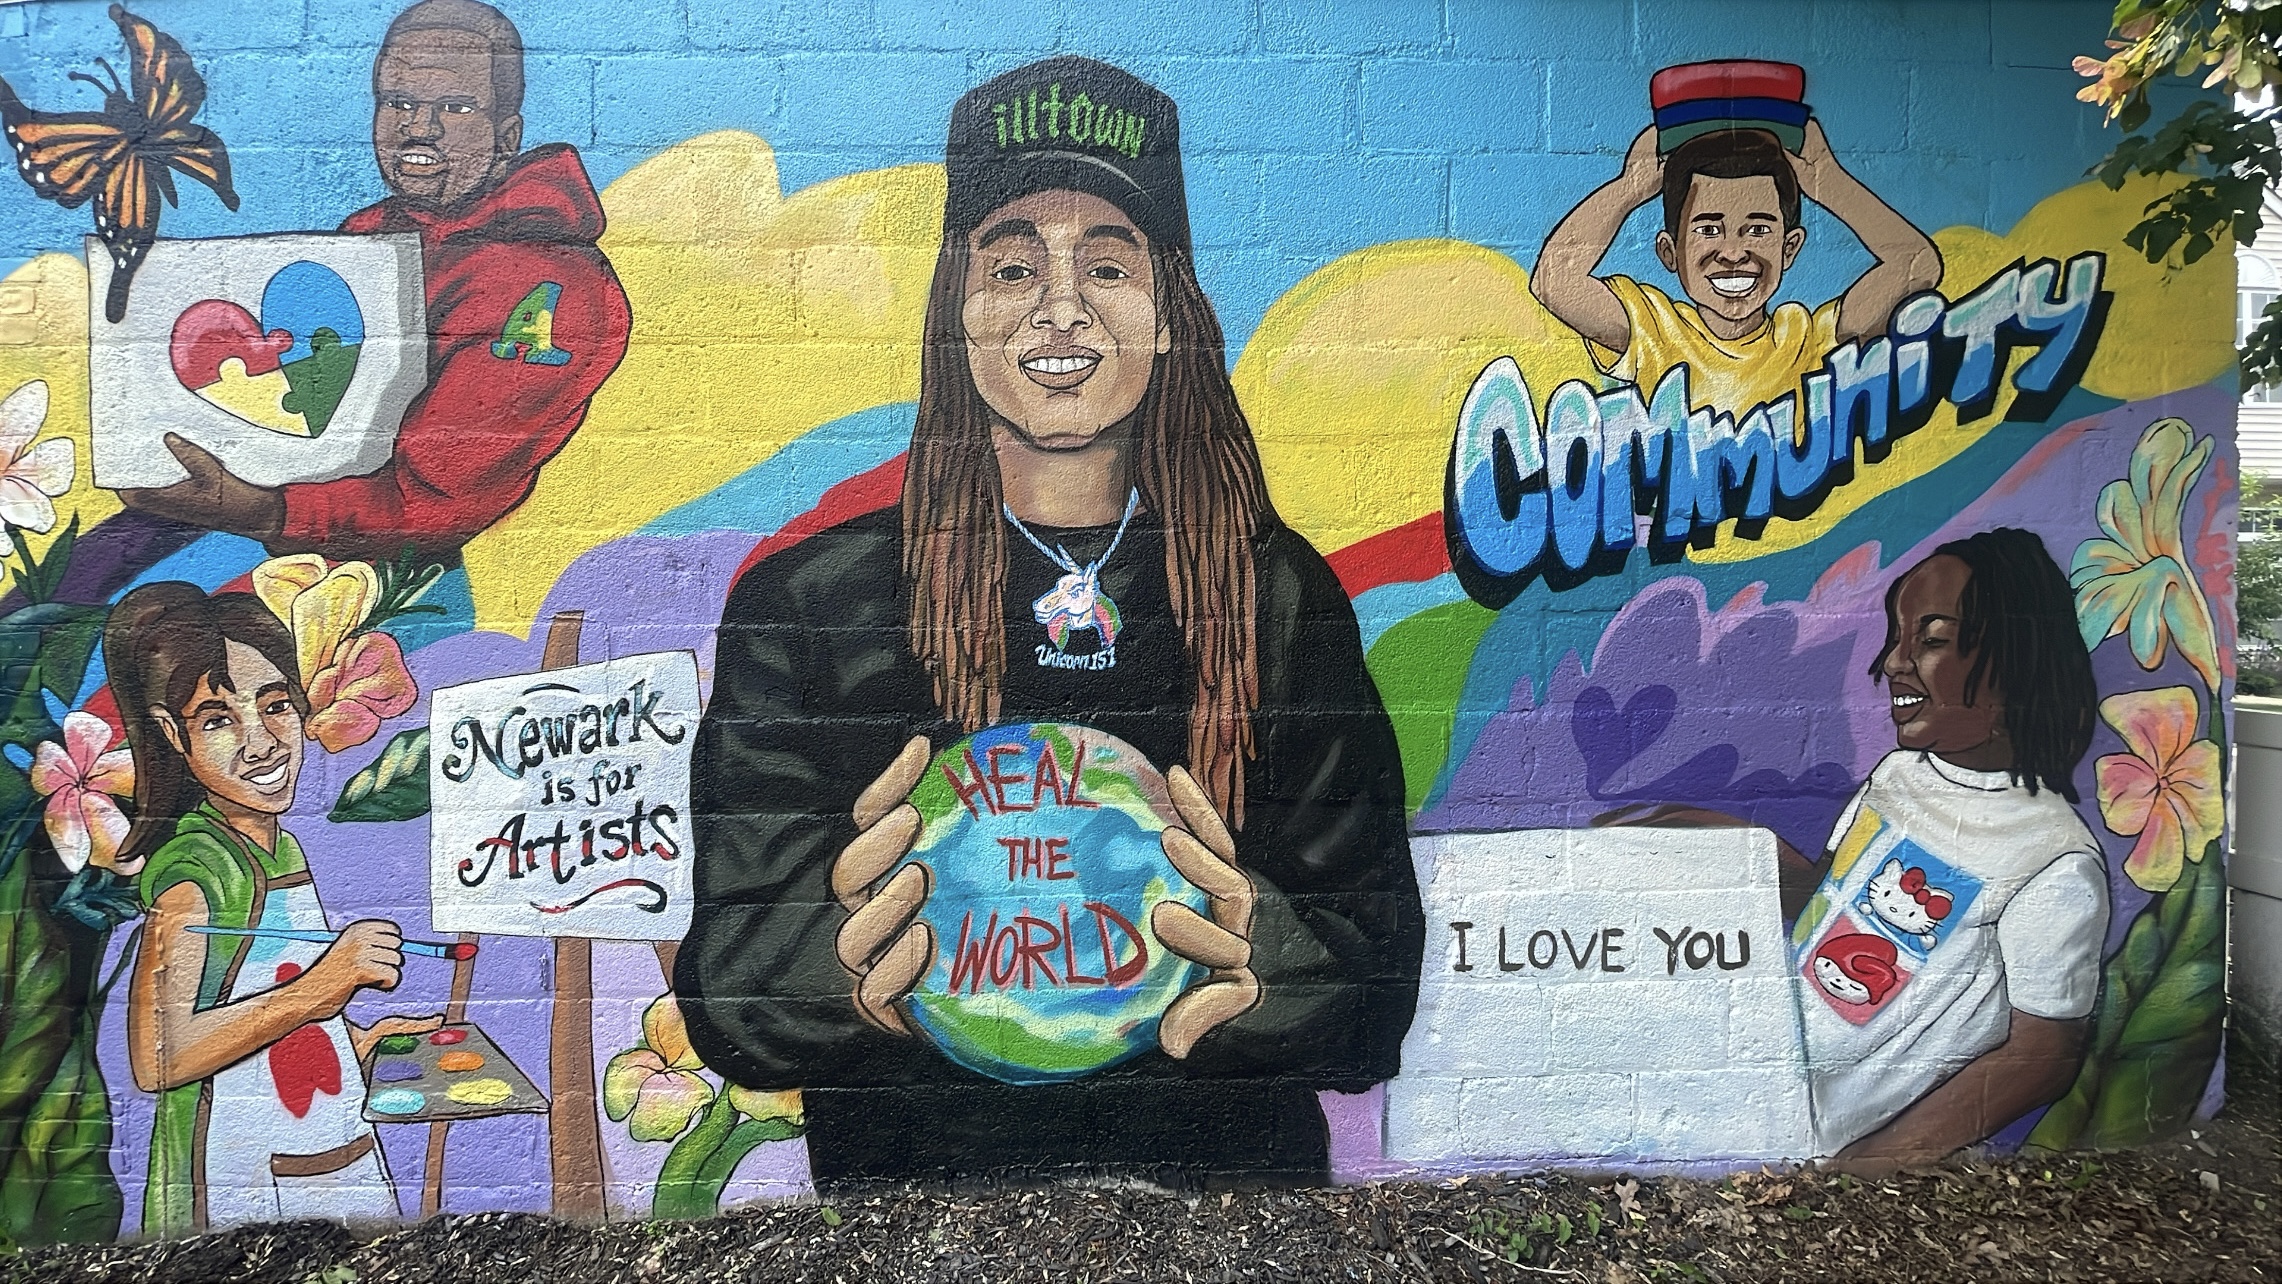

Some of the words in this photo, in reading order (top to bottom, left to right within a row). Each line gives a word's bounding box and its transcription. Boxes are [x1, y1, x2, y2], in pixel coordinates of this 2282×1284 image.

[442, 679, 686, 783] Newark
[540, 770, 576, 805] is
[585, 759, 642, 807] for
[941, 739, 1102, 821] HEAL
[457, 800, 680, 888] Artists
[997, 837, 1078, 882] THE
[949, 901, 1149, 995] WORLD
[1450, 922, 1474, 972] I
[1499, 926, 1626, 972] LOVE
[1652, 926, 1751, 976] YOU
